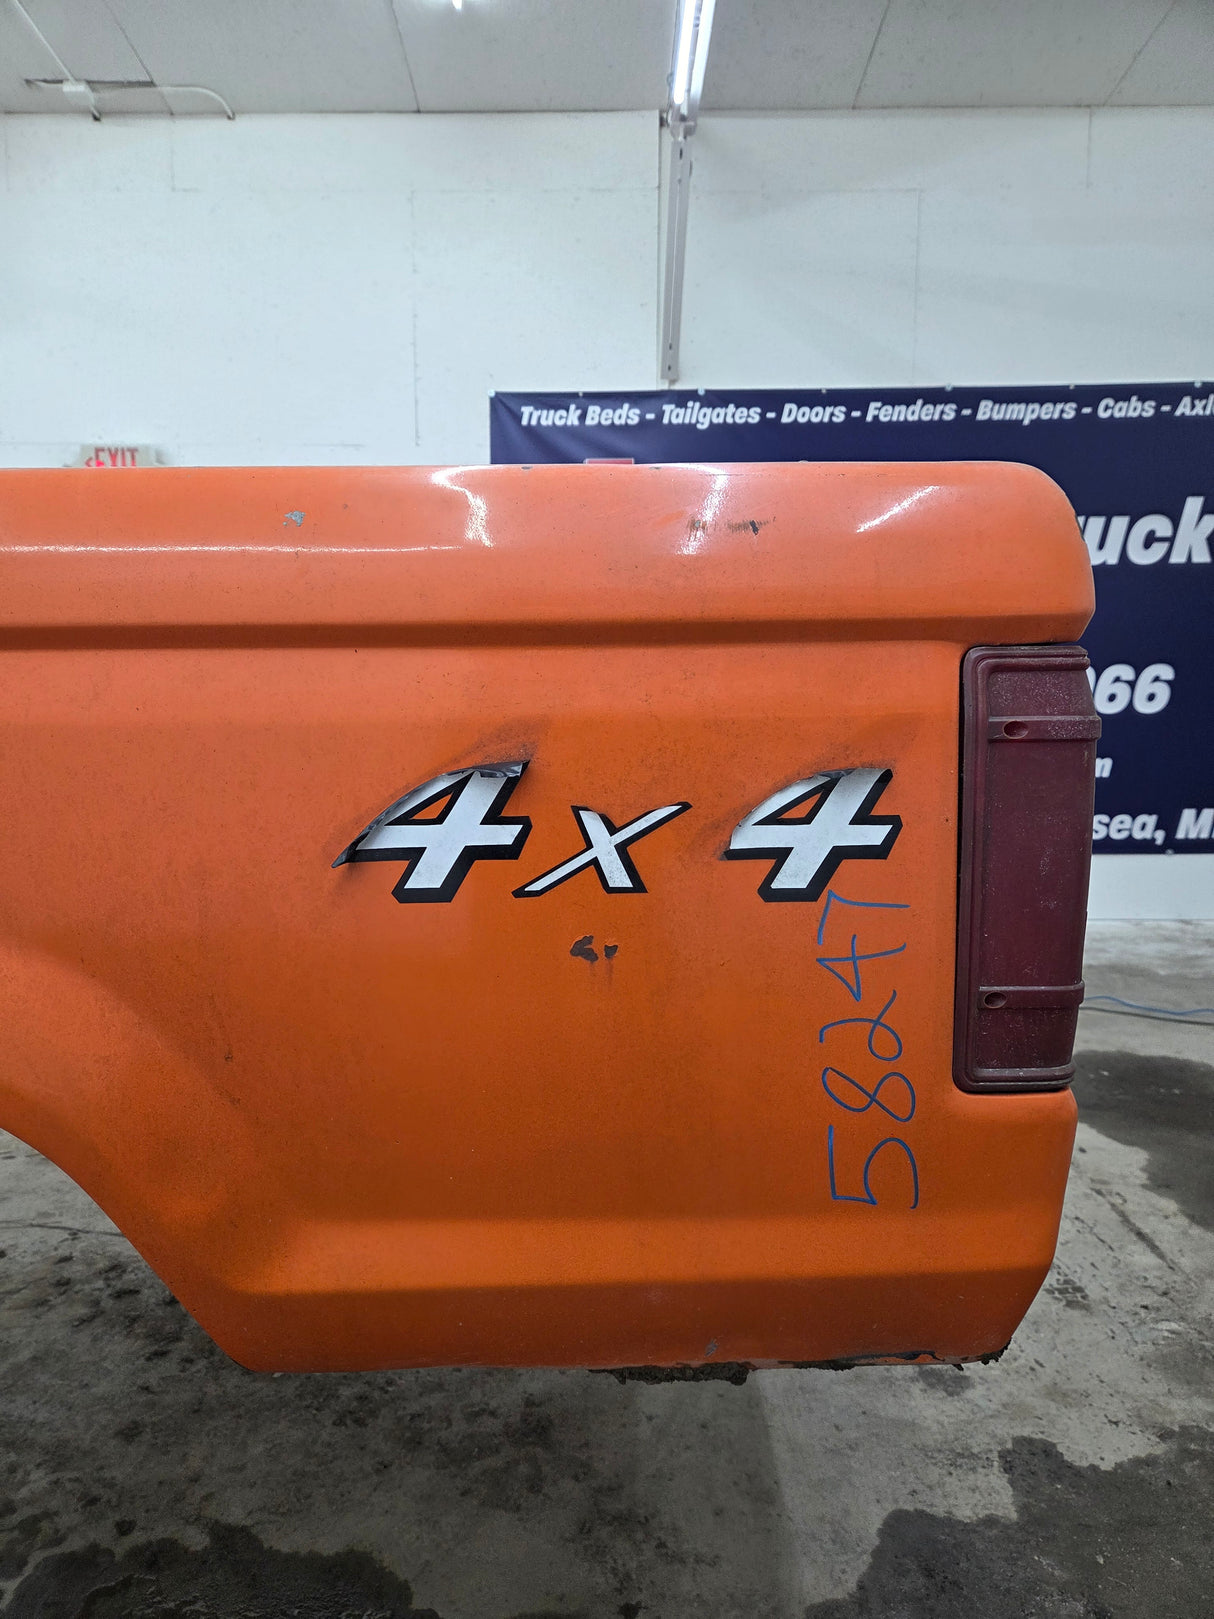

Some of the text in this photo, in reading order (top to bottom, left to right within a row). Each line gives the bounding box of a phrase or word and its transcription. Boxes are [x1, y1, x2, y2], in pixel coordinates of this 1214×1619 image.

[520, 404, 583, 427] Truck
[584, 402, 642, 427] Beds
[661, 400, 762, 431] Tailgates
[780, 403, 847, 424] Doors
[865, 398, 957, 423] Fenders
[975, 399, 1077, 426] Bumpers
[1097, 395, 1156, 419] Cabs
[1174, 393, 1214, 417] Axl
[94, 446, 138, 468] EXIT
[1174, 807, 1214, 840] M
[815, 888, 919, 1210] 58247
